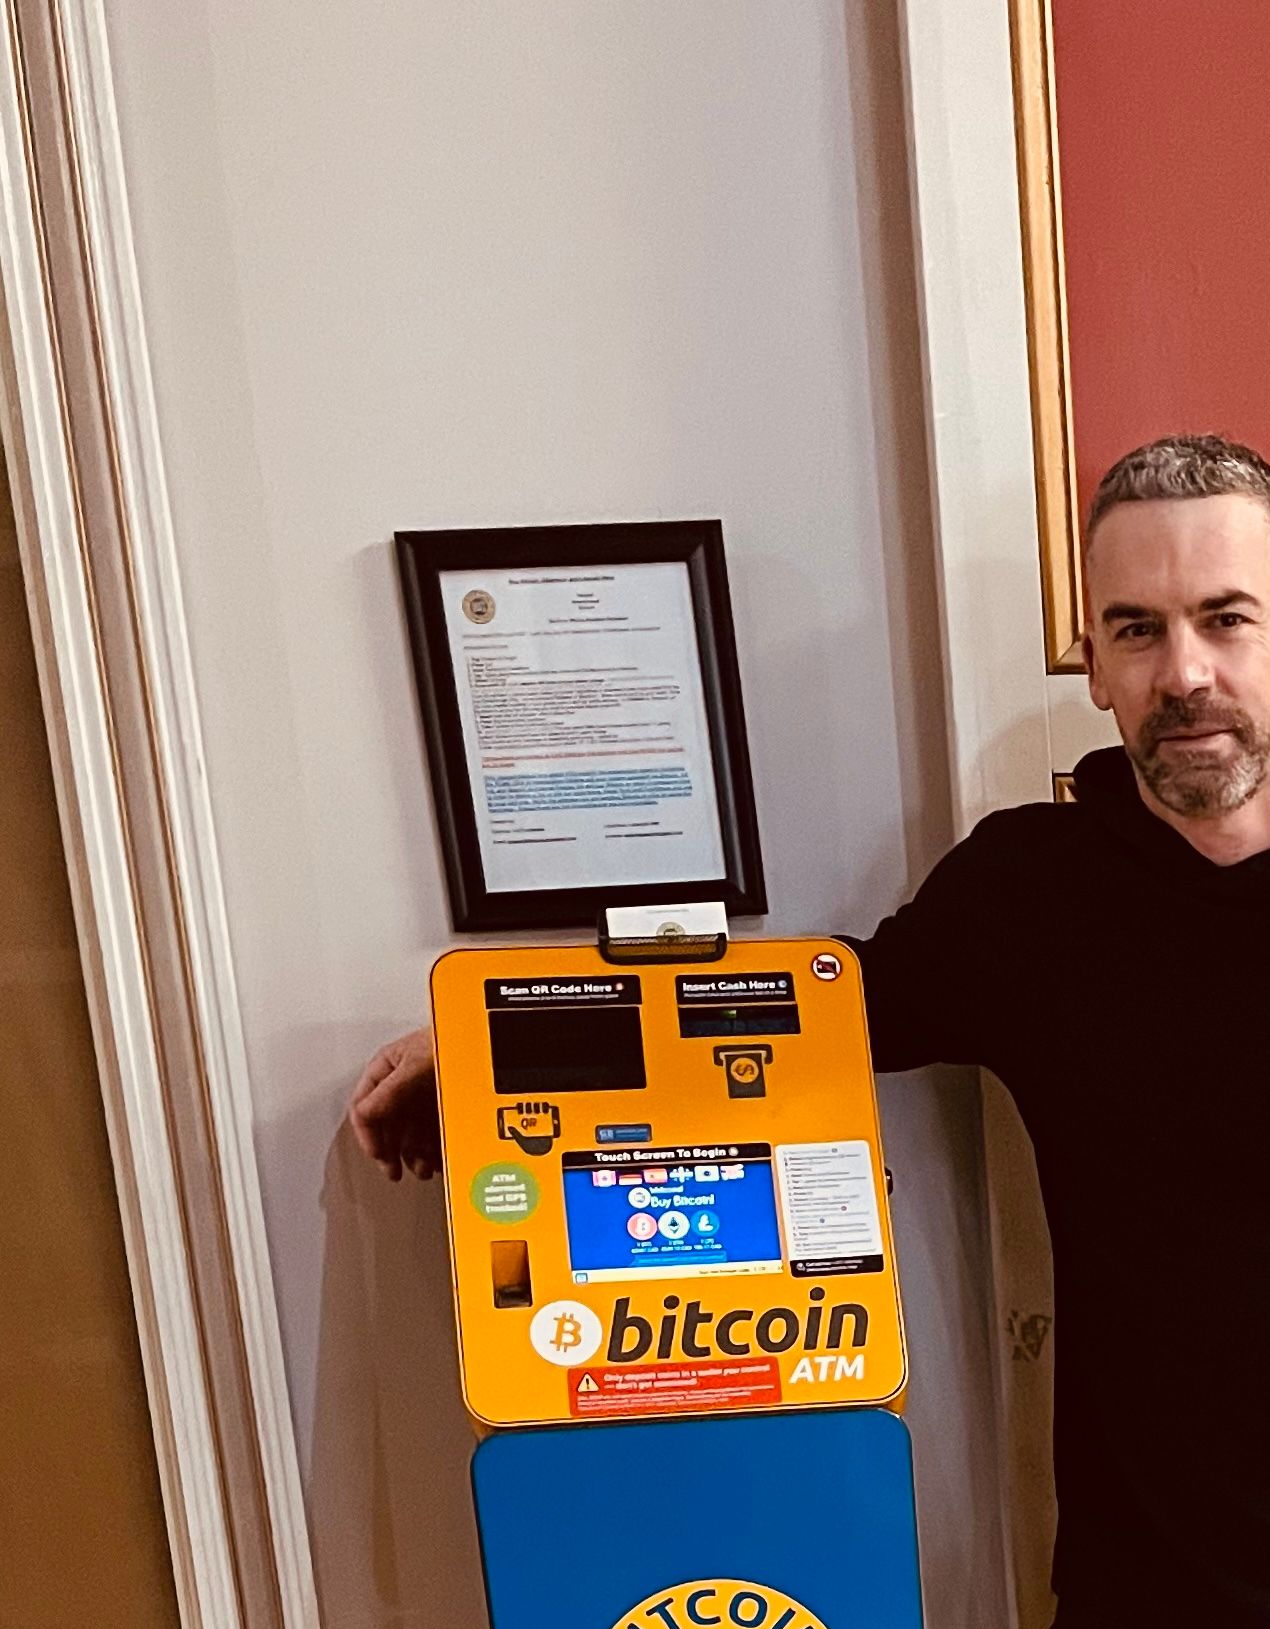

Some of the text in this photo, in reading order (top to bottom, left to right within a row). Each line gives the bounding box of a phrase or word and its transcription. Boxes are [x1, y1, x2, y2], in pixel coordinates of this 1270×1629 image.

[500, 983, 612, 995] Scan QR Code Here
[682, 980, 776, 991] Insert Cash Here
[594, 1147, 726, 1162] Touch Screen To Begin
[650, 1195, 671, 1209] Buy
[607, 1286, 869, 1364] bitcoin
[789, 1354, 864, 1384] ATM
